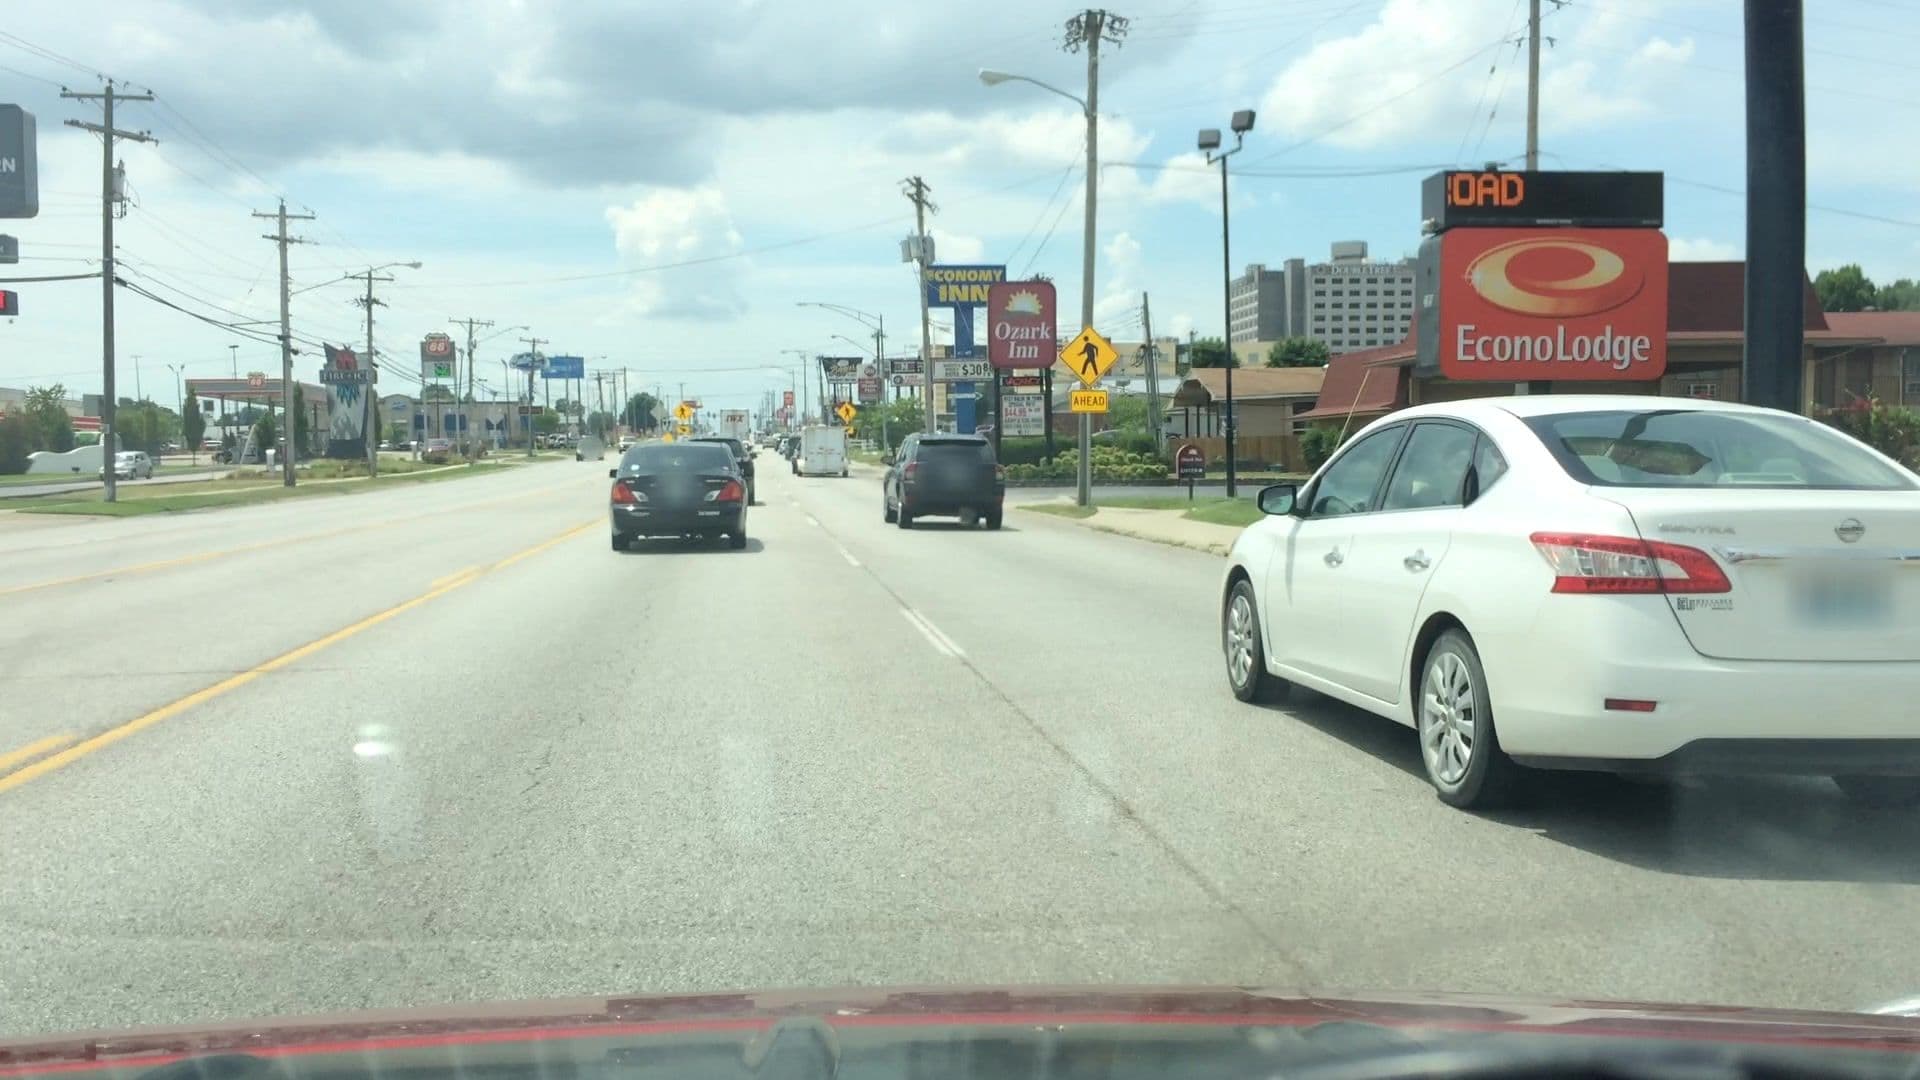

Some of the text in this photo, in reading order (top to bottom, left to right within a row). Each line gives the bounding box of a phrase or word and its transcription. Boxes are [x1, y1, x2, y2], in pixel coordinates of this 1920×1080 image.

[1448, 172, 1524, 206] OAD
[939, 284, 990, 302] INN
[995, 321, 1050, 341] Ozark
[1008, 341, 1039, 359] Inn
[1073, 395, 1105, 407] AHEAD
